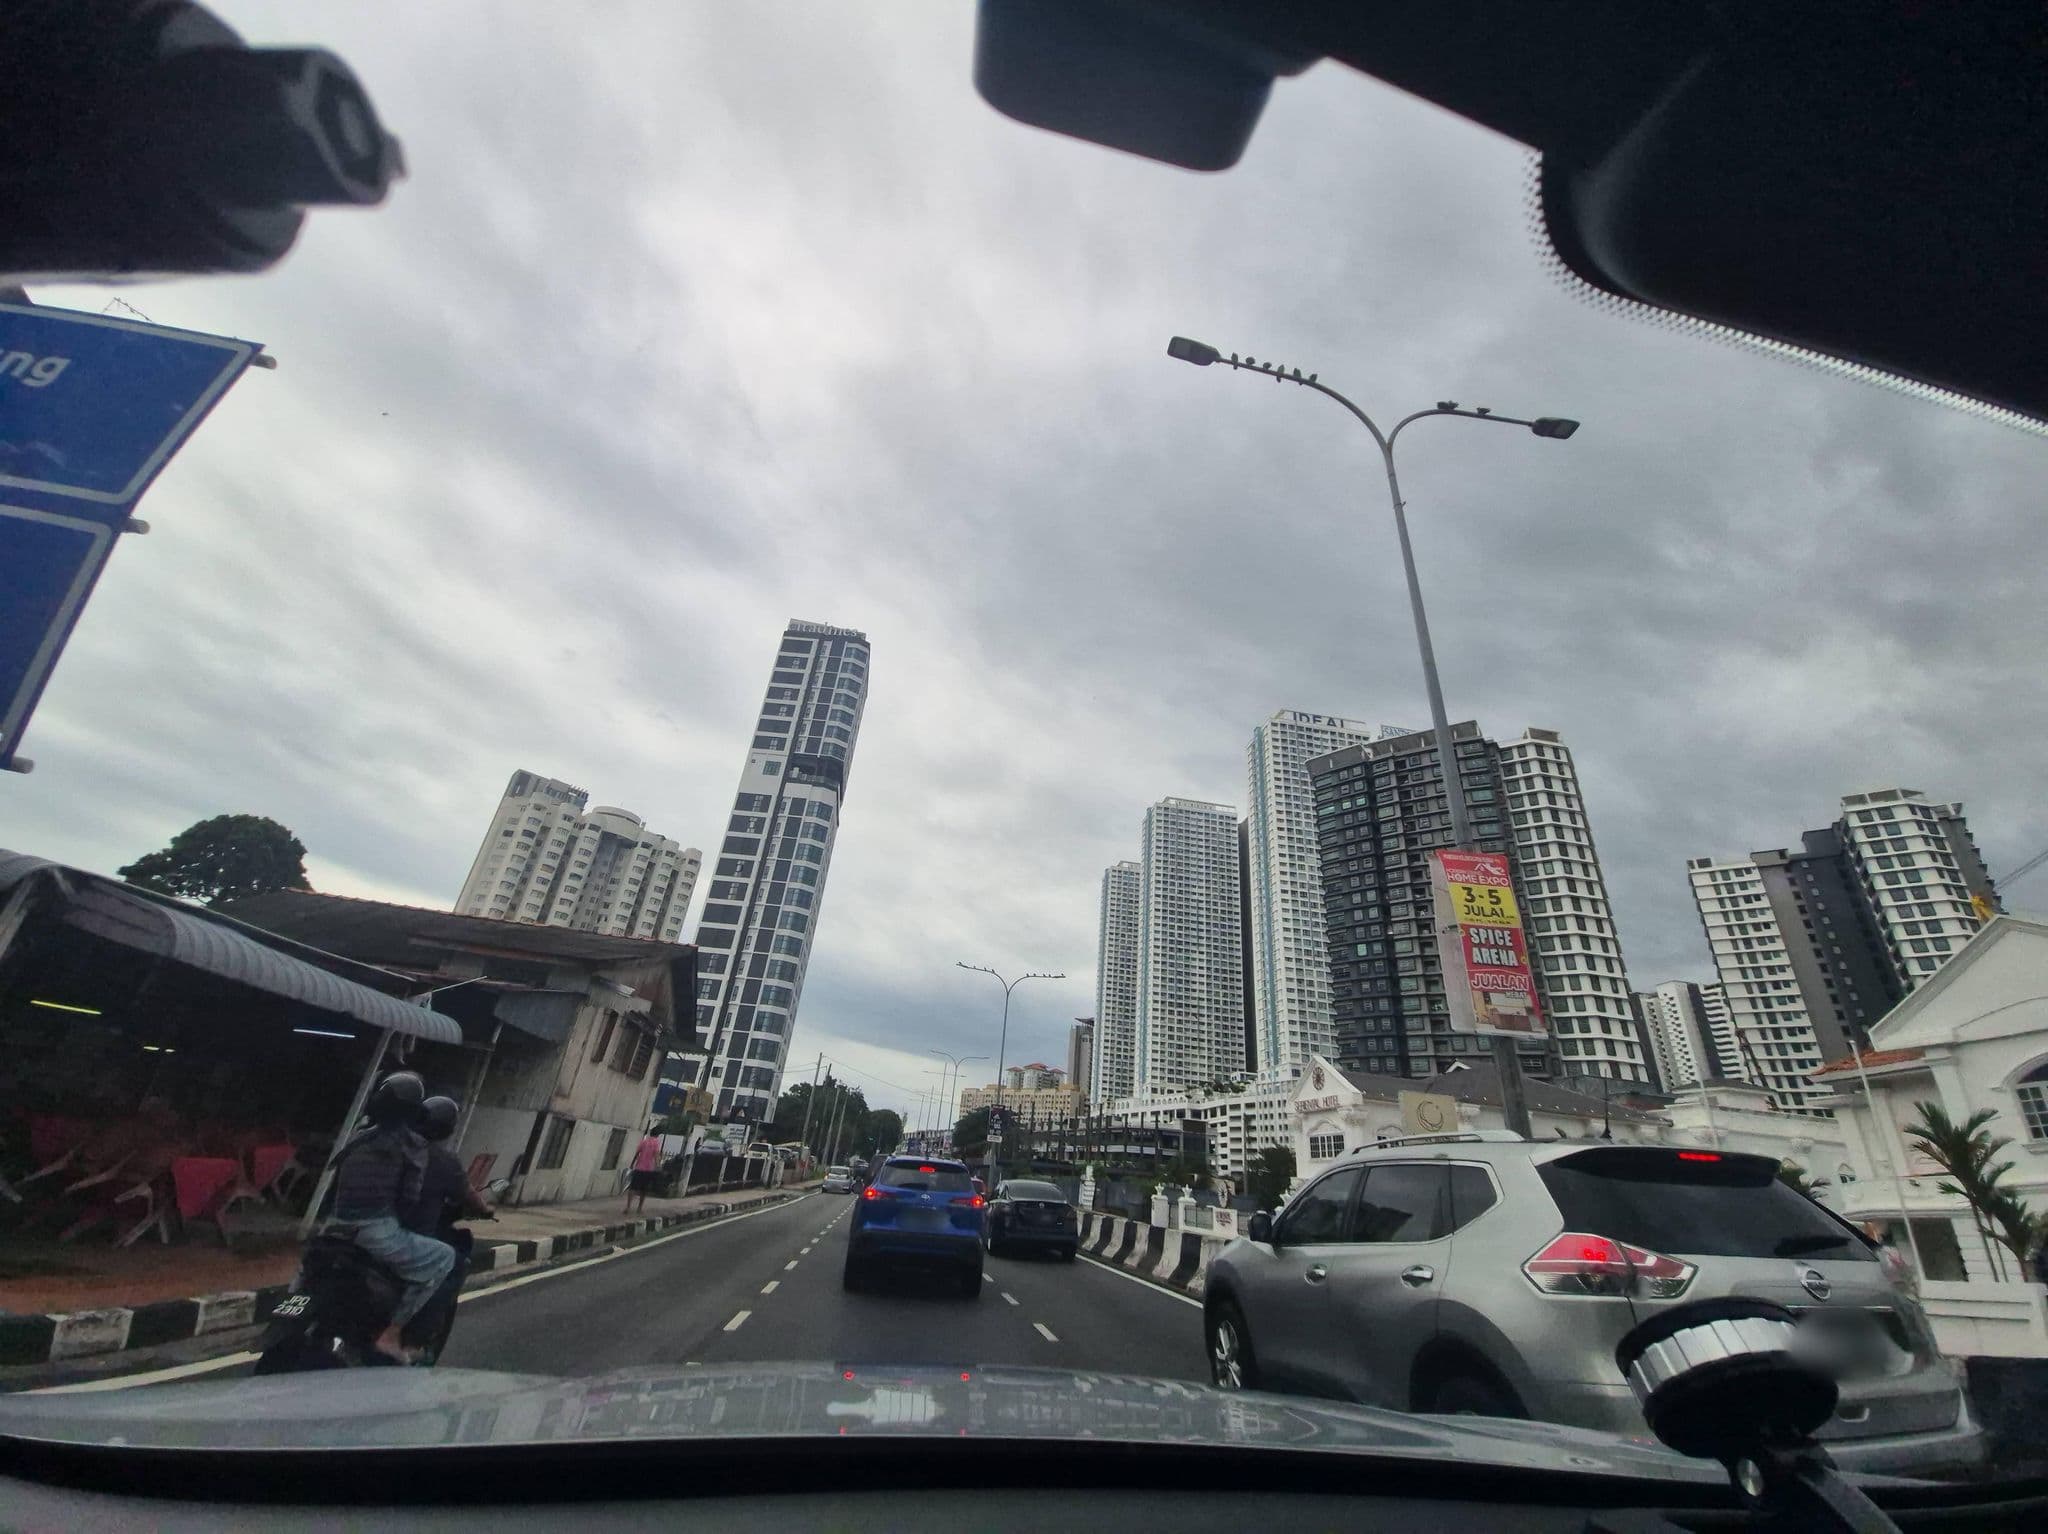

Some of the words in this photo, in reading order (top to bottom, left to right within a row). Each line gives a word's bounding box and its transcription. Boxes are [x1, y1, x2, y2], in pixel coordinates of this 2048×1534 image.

[0, 349, 71, 387] ng
[1447, 873, 1478, 884] HOME
[1479, 875, 1509, 886] EXPO
[1462, 886, 1476, 903] 3
[1488, 888, 1502, 906] 5
[1464, 904, 1505, 919] JULAI
[1470, 927, 1513, 946] SPICE
[1472, 949, 1519, 967] ARENA
[1471, 973, 1529, 991] JUALAN
